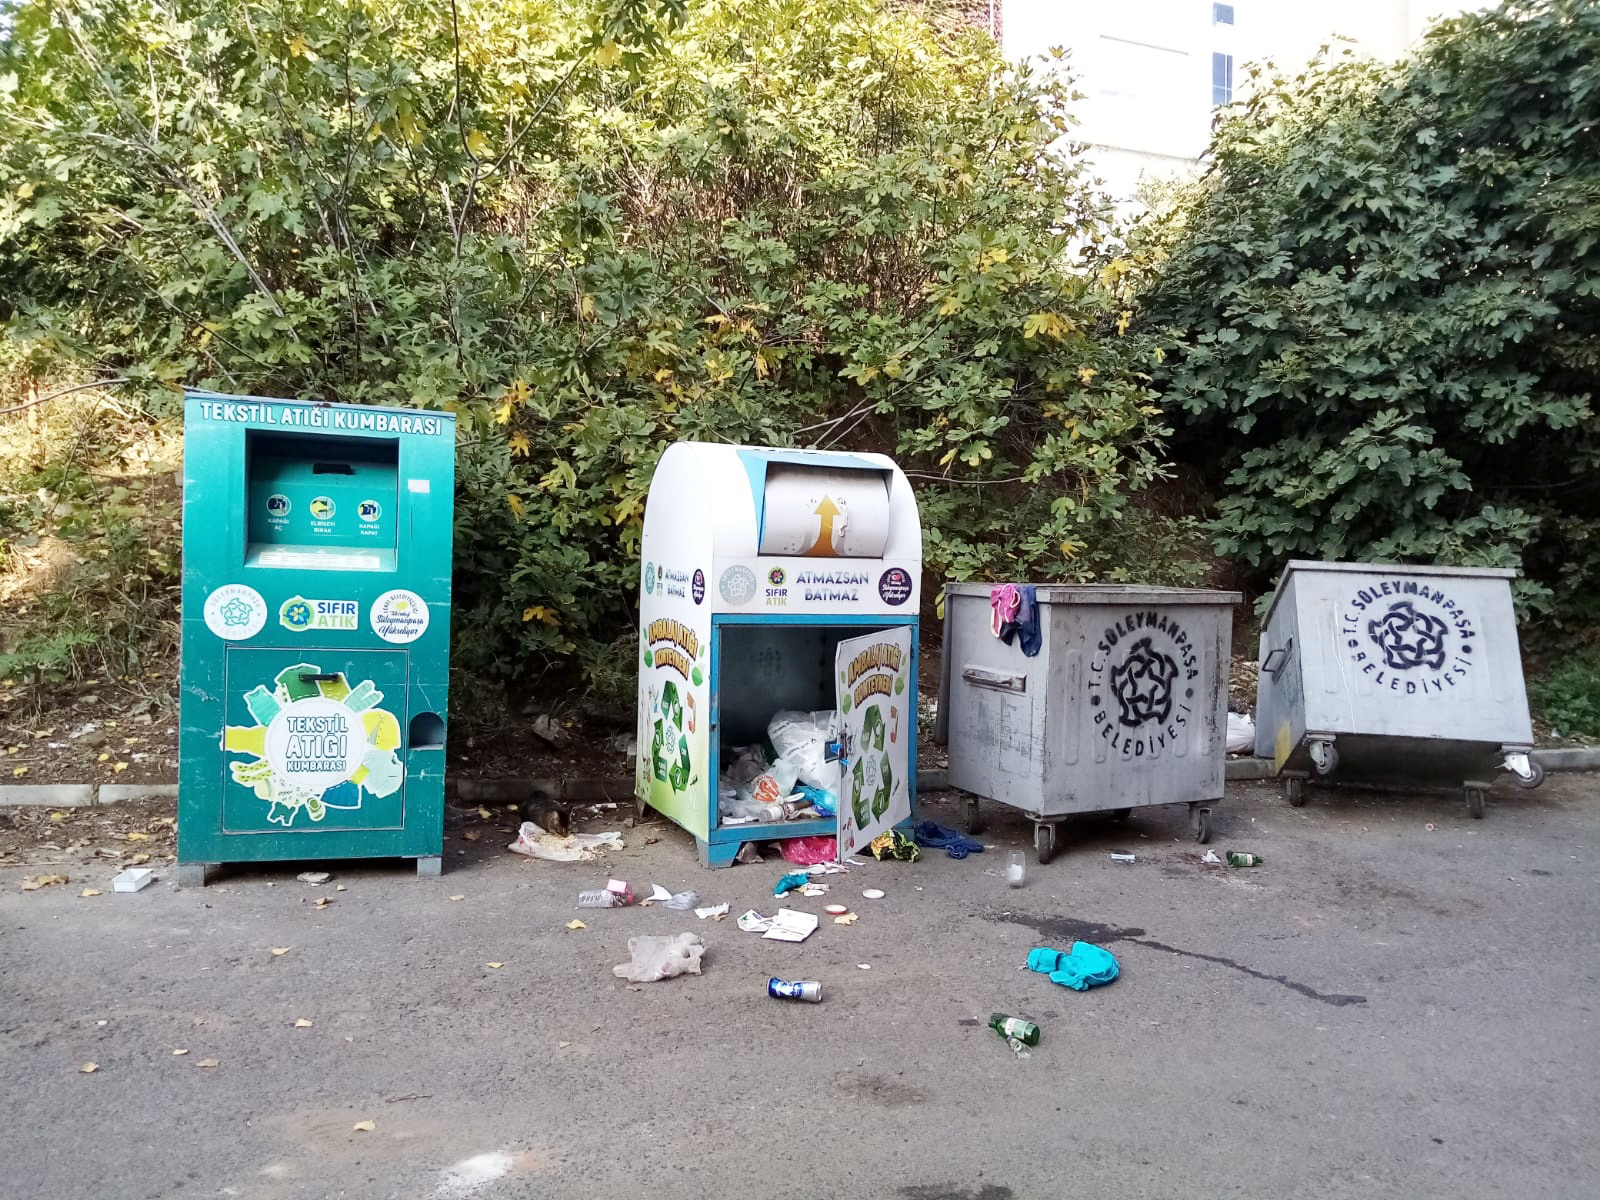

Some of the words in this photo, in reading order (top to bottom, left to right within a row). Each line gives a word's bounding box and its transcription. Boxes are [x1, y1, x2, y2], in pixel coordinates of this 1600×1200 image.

[200, 400, 276, 424] TEKSTİL
[281, 406, 329, 427] ATIĞI
[334, 411, 442, 435] KUMBARASI
[796, 571, 869, 584] ATMAZSAN
[765, 588, 788, 597] SIFIR
[805, 588, 859, 601] BATMAZ
[318, 602, 356, 614] SIFIR
[765, 597, 787, 606] ATIK
[318, 615, 356, 628] ATIK
[287, 713, 349, 733] TEKSTİL
[286, 732, 347, 759] ATIĞI
[287, 760, 347, 773] KUMBARASI
